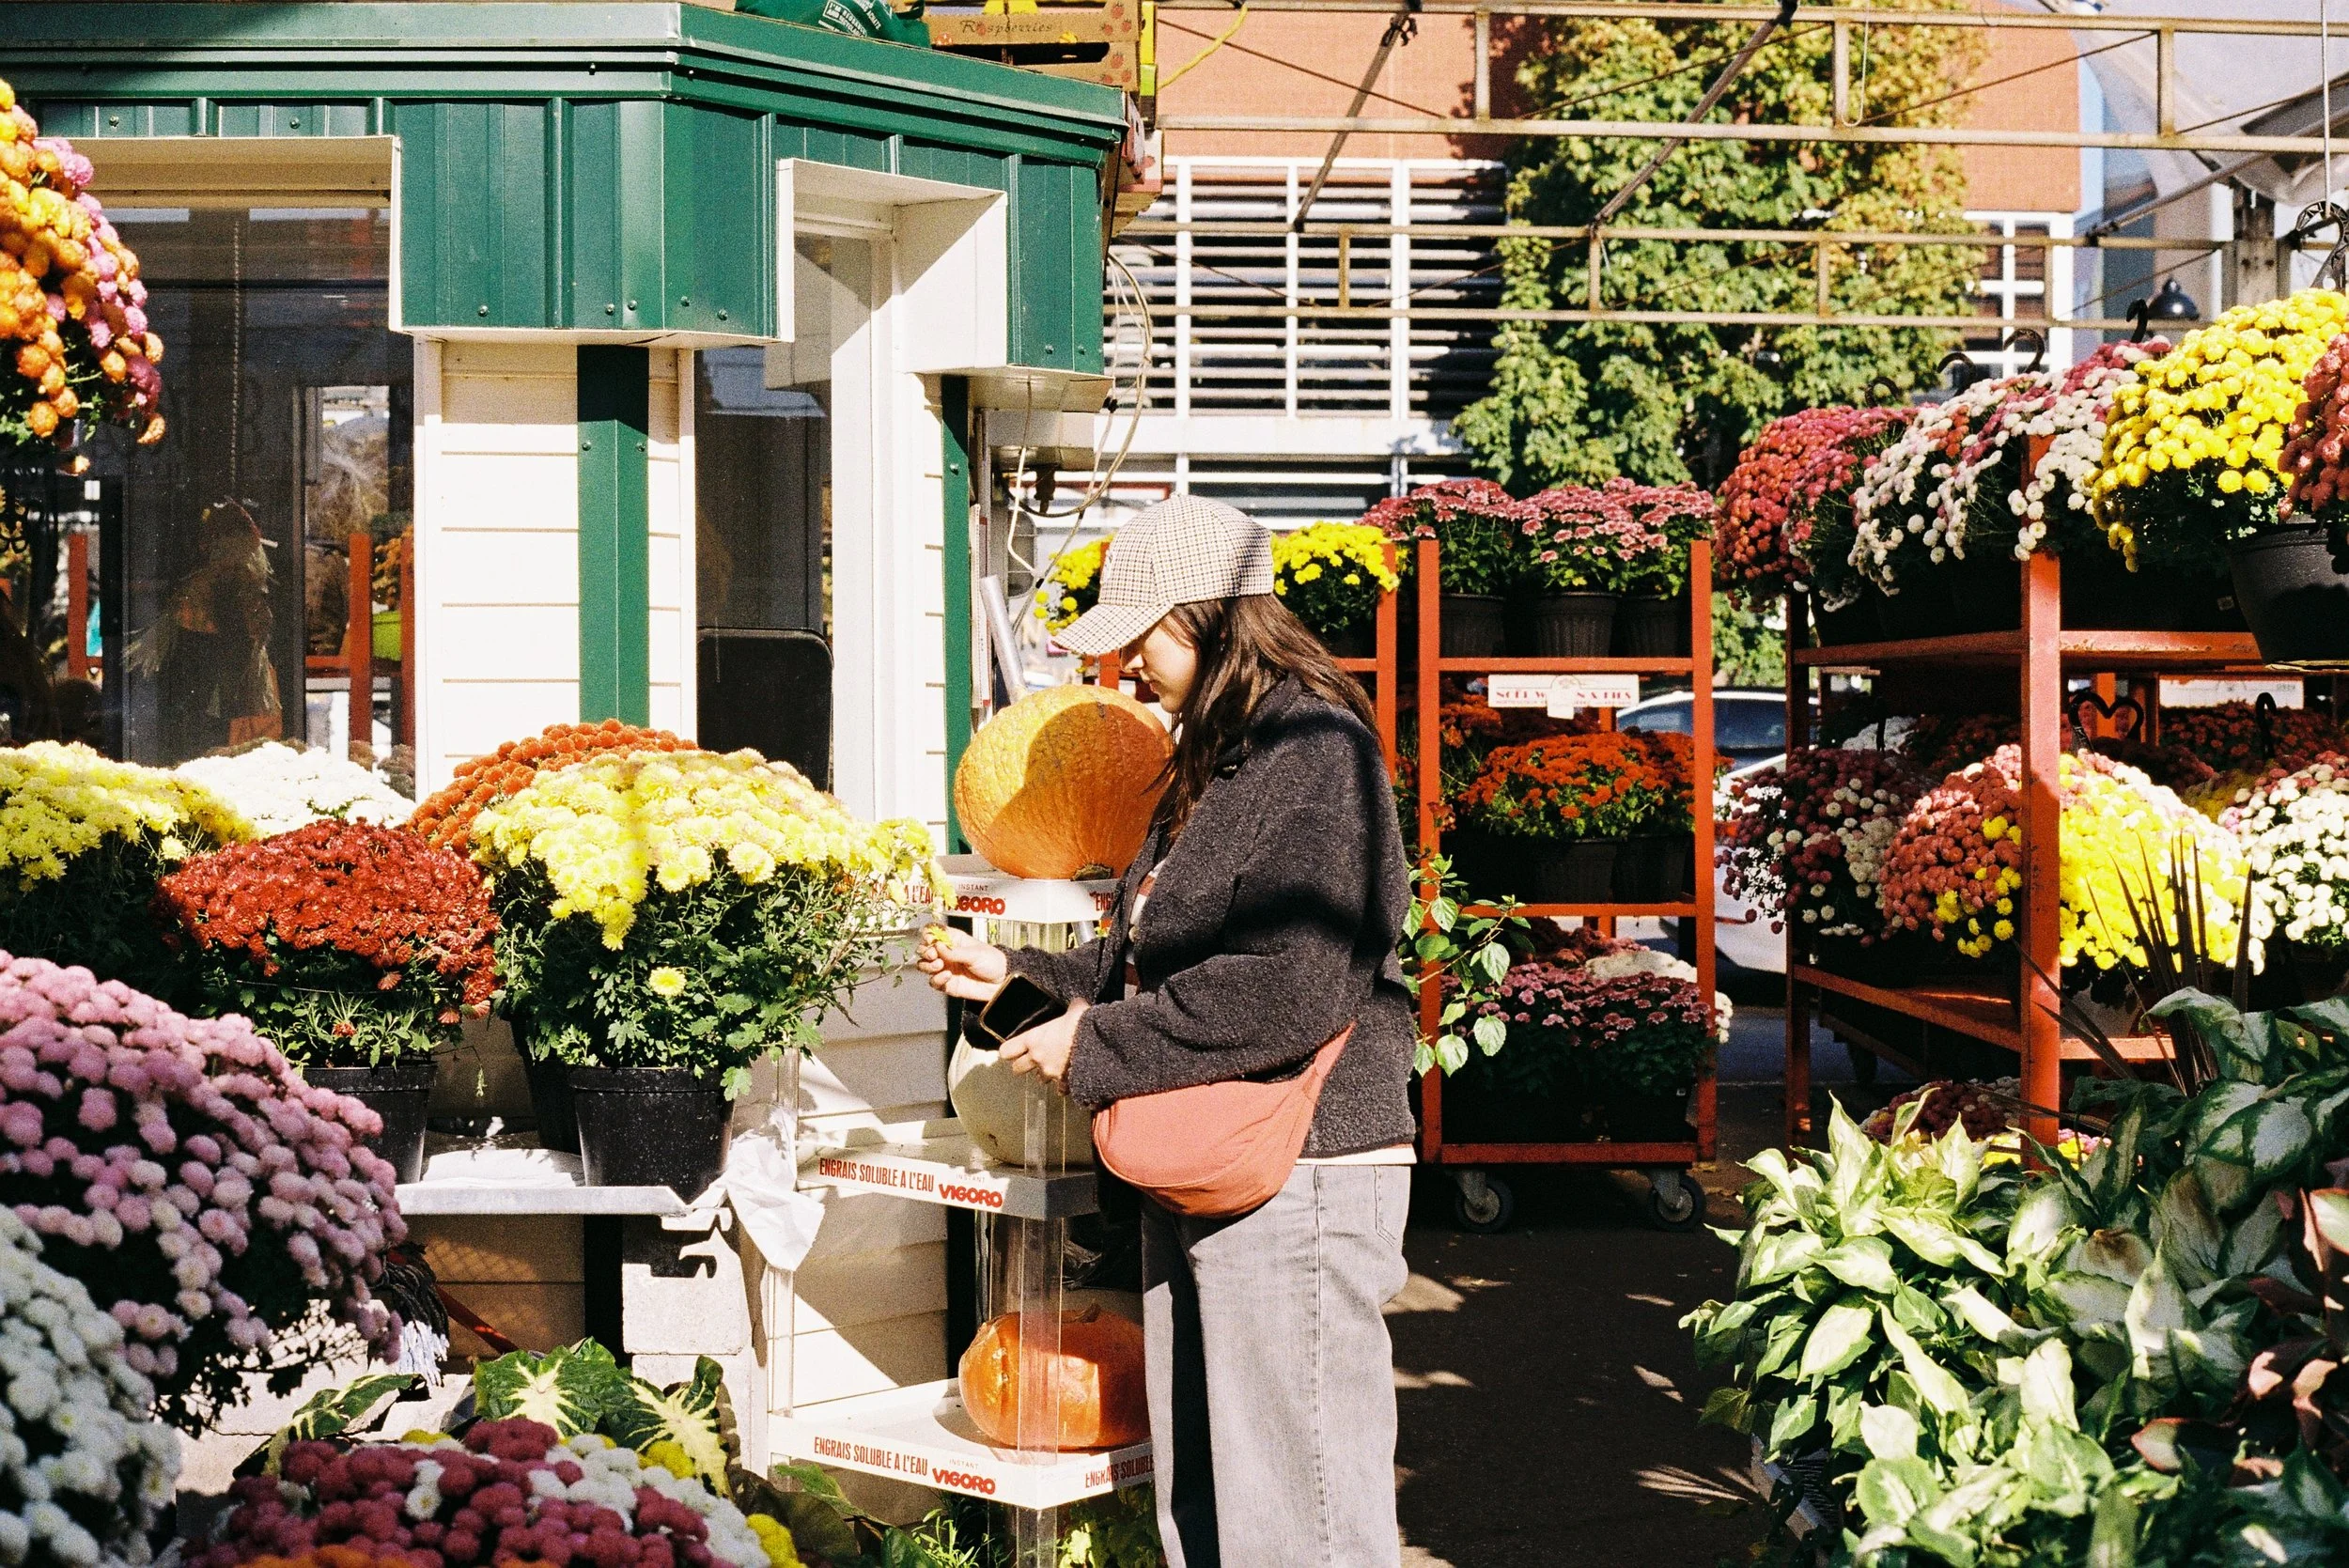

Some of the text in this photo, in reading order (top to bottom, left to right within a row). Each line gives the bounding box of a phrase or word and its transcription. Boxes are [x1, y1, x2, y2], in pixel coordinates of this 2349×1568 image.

[957, 883, 989, 892] INSTANT
[819, 1157, 935, 1192] ENGRAIS SOLUBLE A L'EAU
[938, 1184, 1003, 1208] VIGORO
[814, 1436, 928, 1476] ENGRAIS SOLUBLE A L'EAU
[949, 1458, 979, 1470] INSTANT
[932, 1467, 997, 1495] VIGORO
[1085, 1464, 1119, 1488] ENGRAIS
